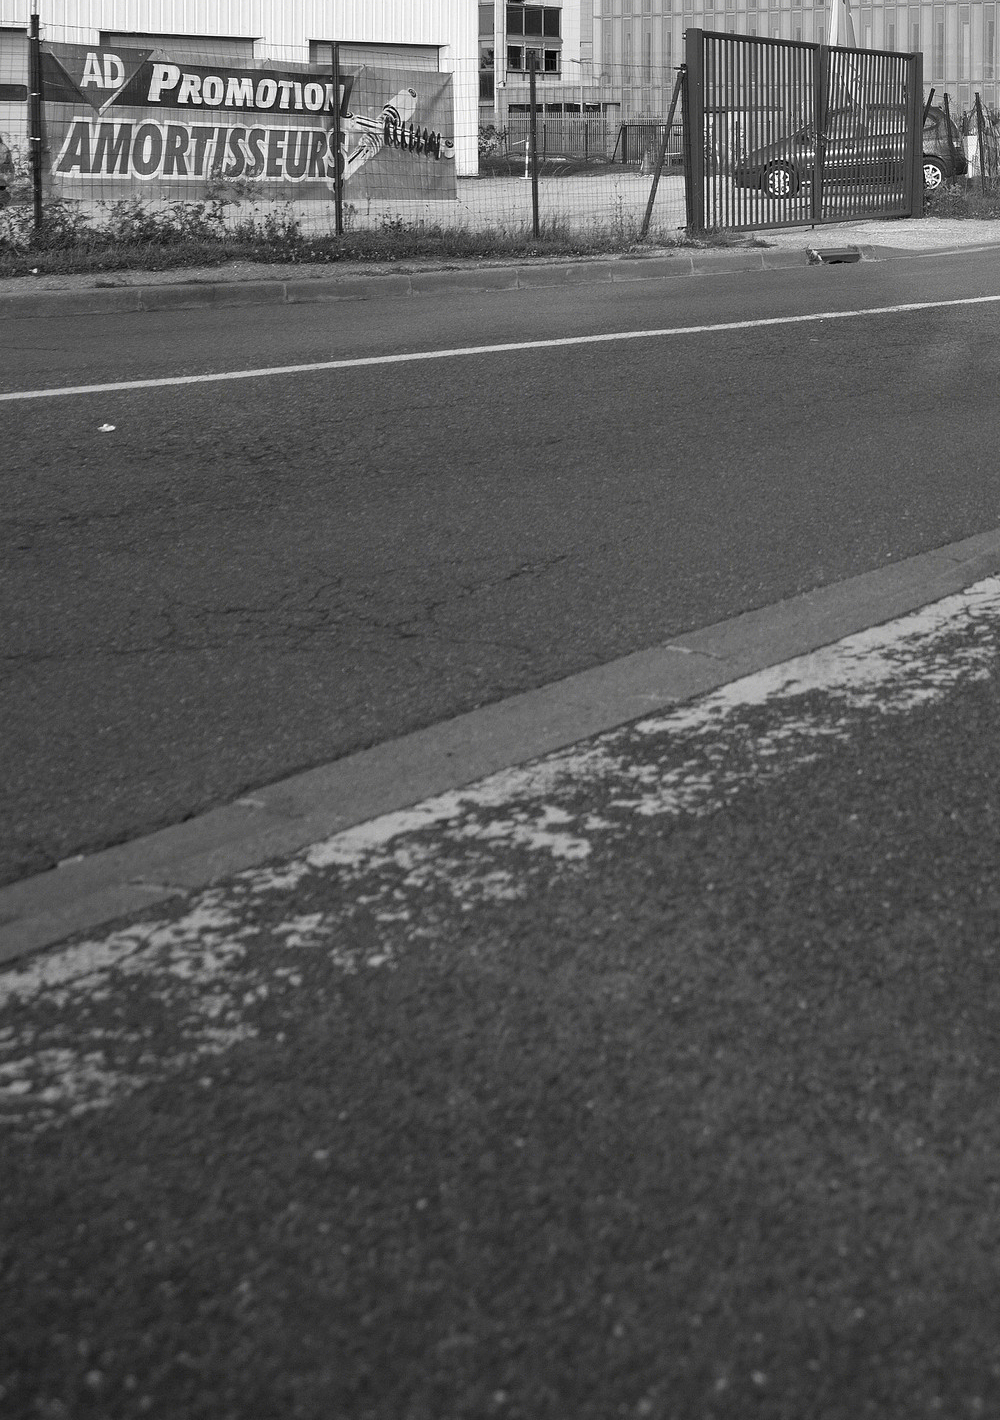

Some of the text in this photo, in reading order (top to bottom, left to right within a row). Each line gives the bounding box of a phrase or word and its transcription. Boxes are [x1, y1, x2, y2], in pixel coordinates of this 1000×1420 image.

[79, 52, 126, 89] AD
[147, 63, 346, 113] PROMOTION
[52, 115, 349, 182] AMORTISSEURS
